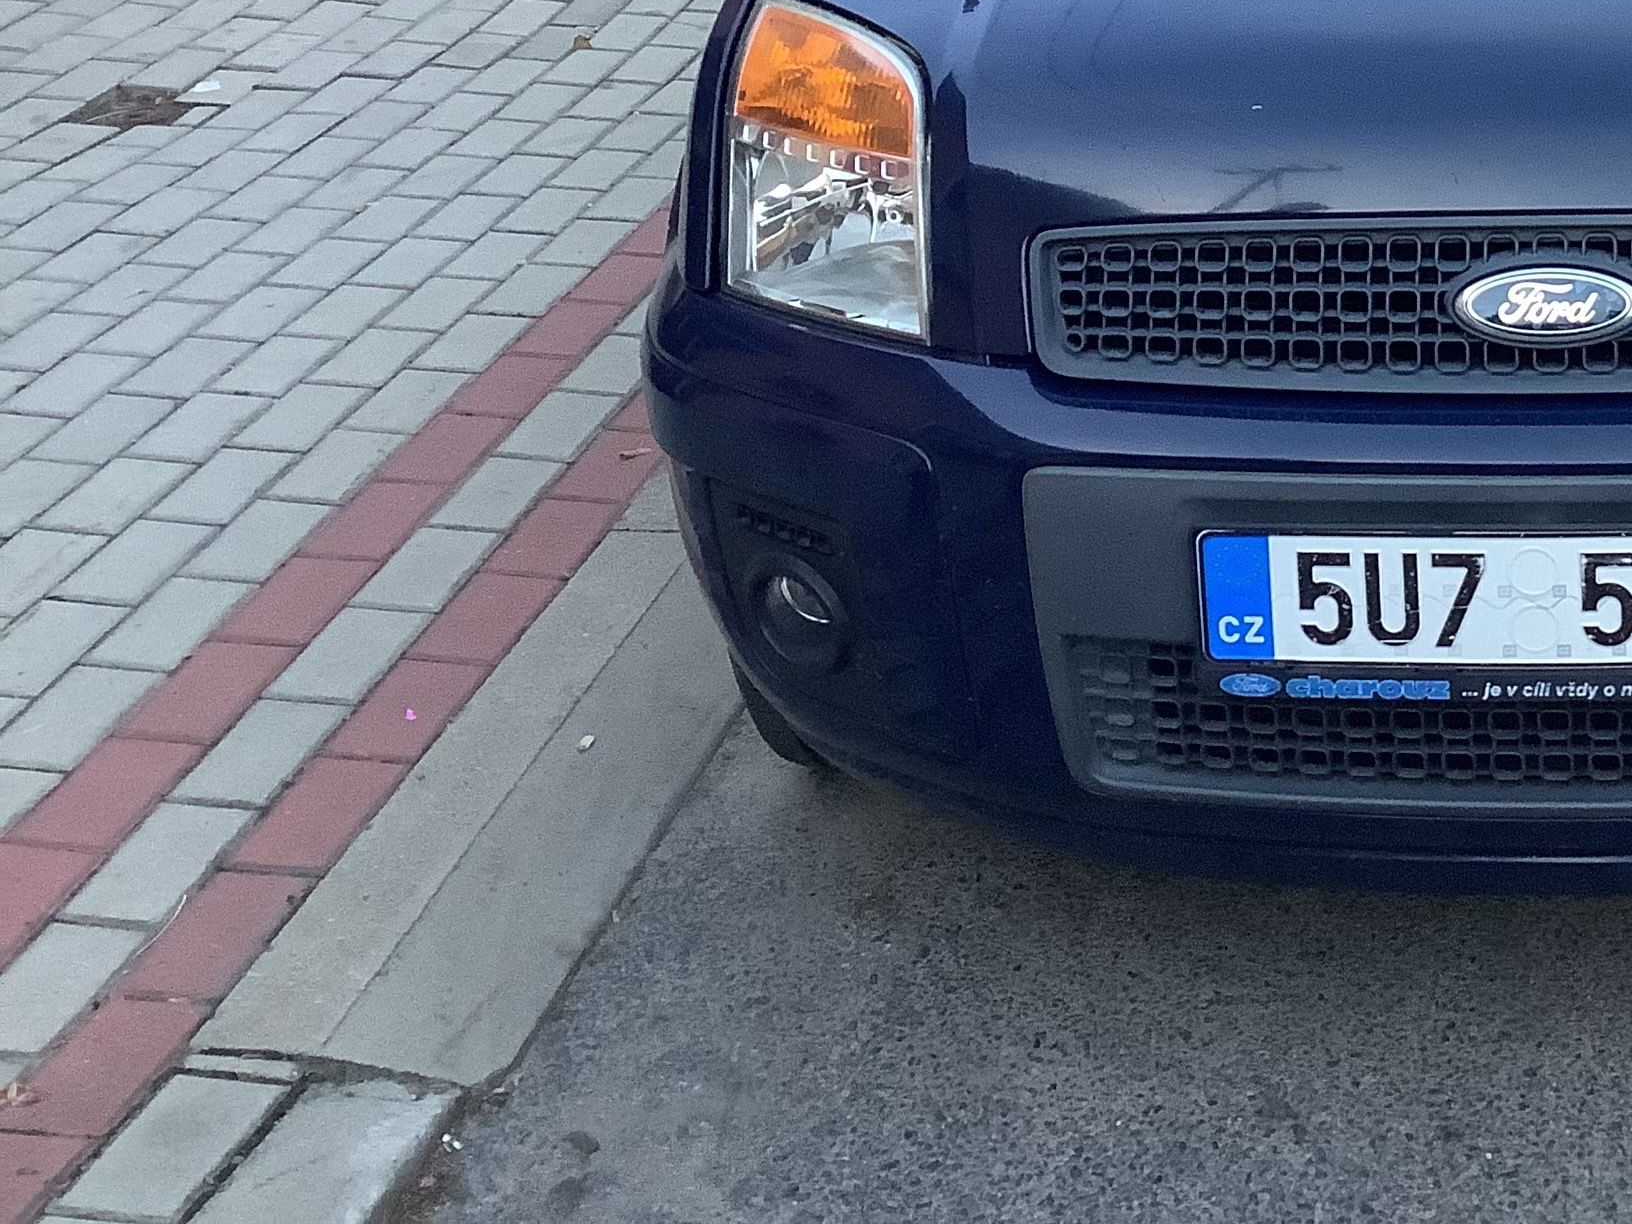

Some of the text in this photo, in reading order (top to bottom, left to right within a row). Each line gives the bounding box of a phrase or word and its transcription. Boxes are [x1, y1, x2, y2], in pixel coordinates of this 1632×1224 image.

[1498, 281, 1599, 325] Ford
[1296, 551, 1486, 647] 5U7
[1217, 615, 1265, 643] CZ
[1286, 675, 1450, 699] charouz
[1482, 682, 1501, 700] je
[1507, 685, 1518, 697] v
[1556, 681, 1599, 700] vždy
[1603, 684, 1616, 697] o
